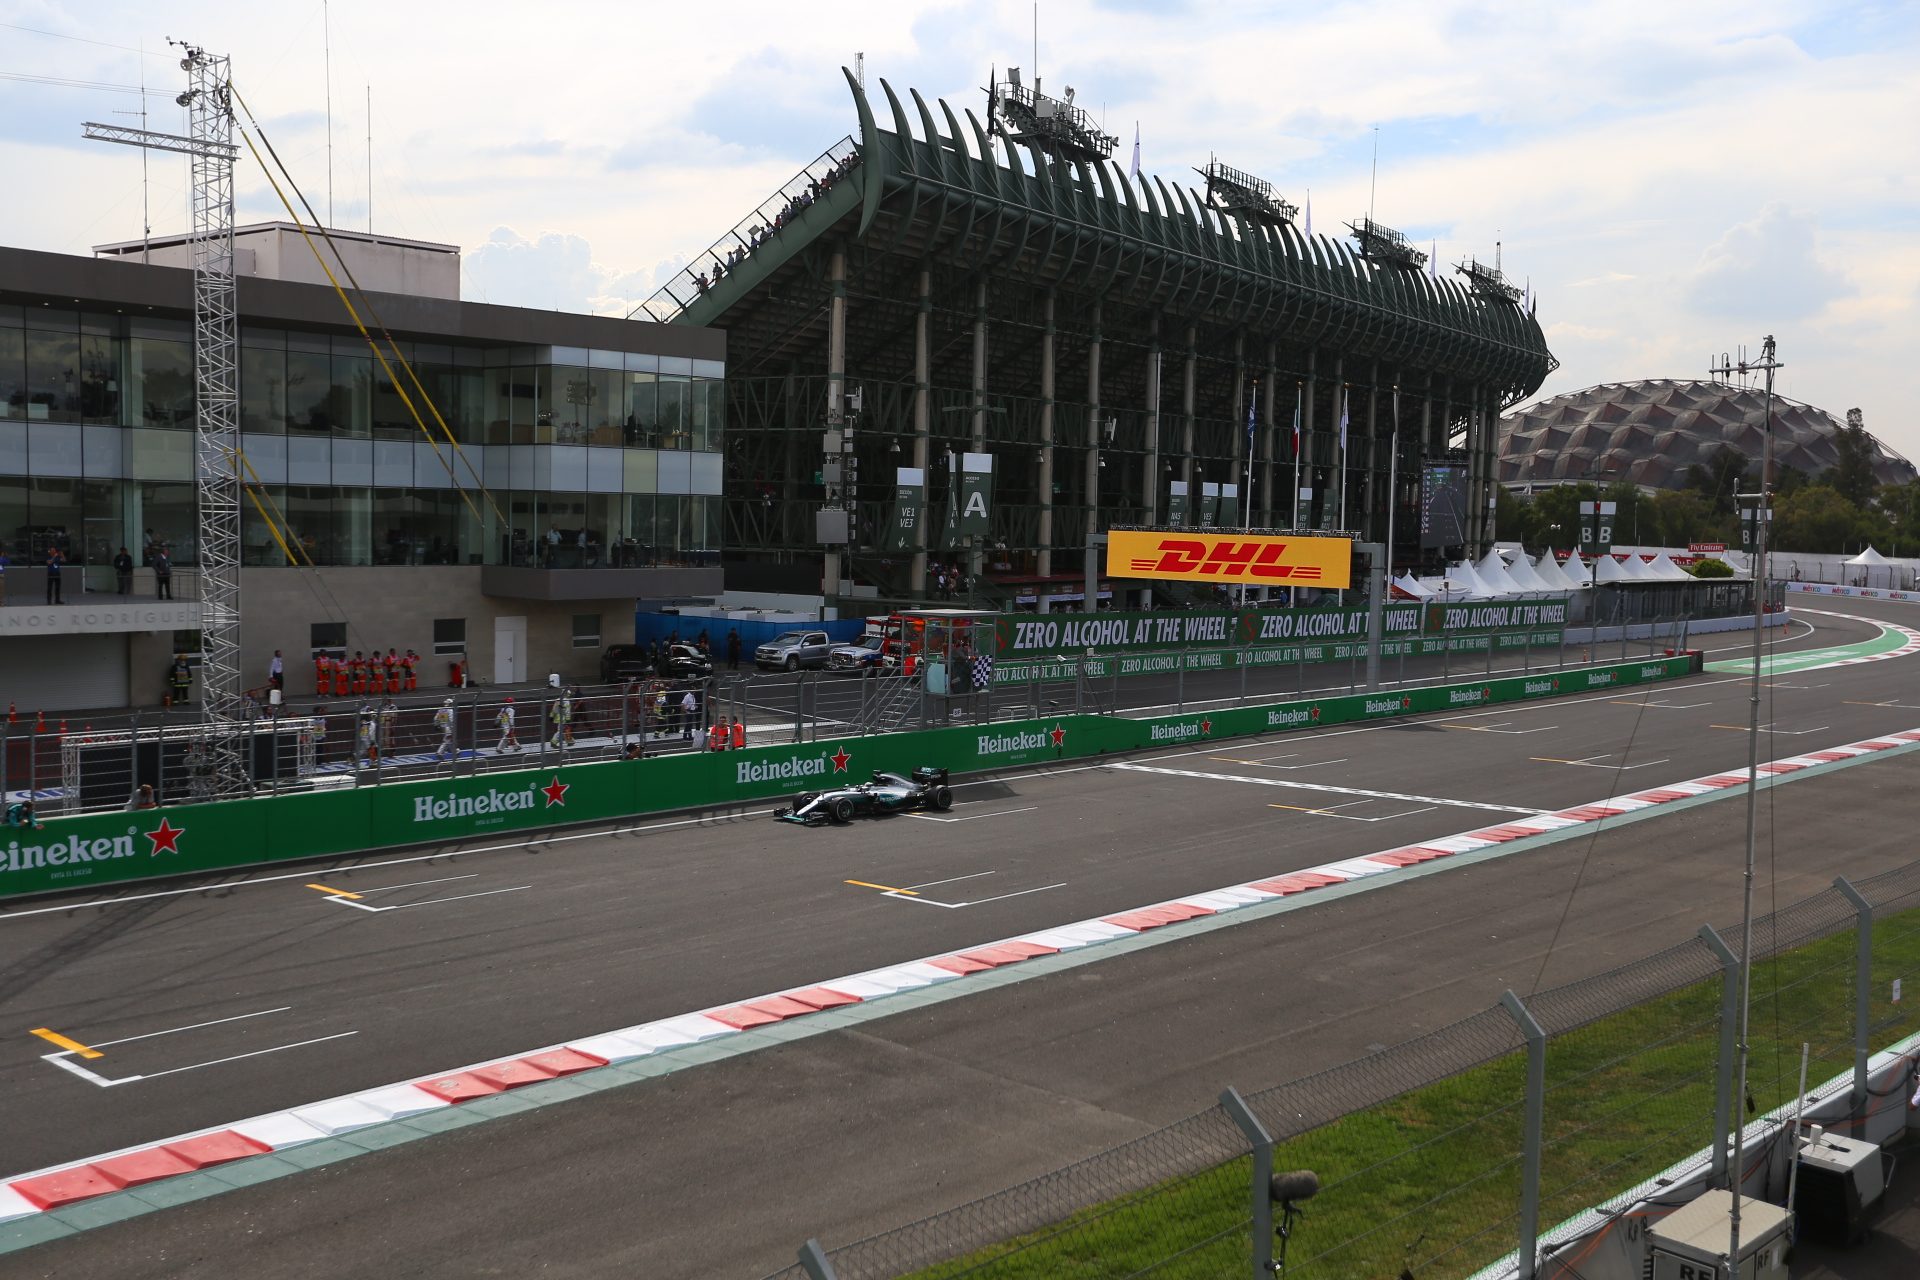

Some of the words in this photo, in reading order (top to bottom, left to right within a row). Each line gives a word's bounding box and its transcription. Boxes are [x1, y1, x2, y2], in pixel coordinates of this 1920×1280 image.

[901, 507, 915, 517] VE1
[963, 491, 987, 518] A
[900, 518, 914, 528] VE3
[1582, 527, 1592, 543] B
[1599, 526, 1611, 543] B
[1742, 530, 1750, 544] B
[1154, 540, 1294, 578] DHL
[1260, 614, 1293, 639] ZERO
[1294, 612, 1345, 637] ALCOHOL
[1347, 612, 1362, 634] AT
[1386, 609, 1418, 631] WHEEL
[1443, 608, 1469, 629] ZERO
[1469, 607, 1509, 628] ALCOHOL
[1511, 606, 1522, 625] AT
[1523, 606, 1538, 625] THE
[1540, 604, 1565, 624] WHEEL
[1014, 621, 1057, 649] ZERO
[1061, 619, 1129, 647] ALCOHOL
[1133, 619, 1152, 644] AT
[1156, 618, 1181, 643] THE
[1184, 616, 1226, 641] WHEEL
[1335, 645, 1350, 658] ZERO
[1384, 643, 1394, 655] THE
[1395, 642, 1412, 654] WEEL
[1423, 641, 1436, 652] ZERO
[1459, 639, 1465, 649] AT
[1466, 638, 1475, 649] THE
[1475, 637, 1489, 649] WHEE
[1121, 659, 1141, 673] ZERO
[1143, 657, 1175, 671] ALCOHOL
[1187, 655, 1199, 667] THE
[1200, 654, 1222, 666] WHEEL
[1254, 650, 1282, 664] ALCOHOL
[1283, 649, 1291, 662] AT
[1292, 648, 1300, 661] TH
[1304, 647, 1323, 661] WHEEL
[1051, 666, 1060, 678] AT
[1588, 673, 1611, 685] Heineken
[1641, 666, 1662, 677] Heineken
[1525, 681, 1551, 694] Heineken
[1450, 690, 1482, 703] Heineken
[1366, 699, 1400, 713] Heineken
[1268, 710, 1309, 725] Heineken
[1151, 723, 1198, 740] Heineken
[977, 731, 1046, 755] Heineken
[736, 756, 826, 784] Heineken
[414, 788, 535, 822] Heineken
[51, 871, 65, 880] EVITA
[66, 870, 72, 878] EL
[1757, 1249, 1770, 1271] RF
